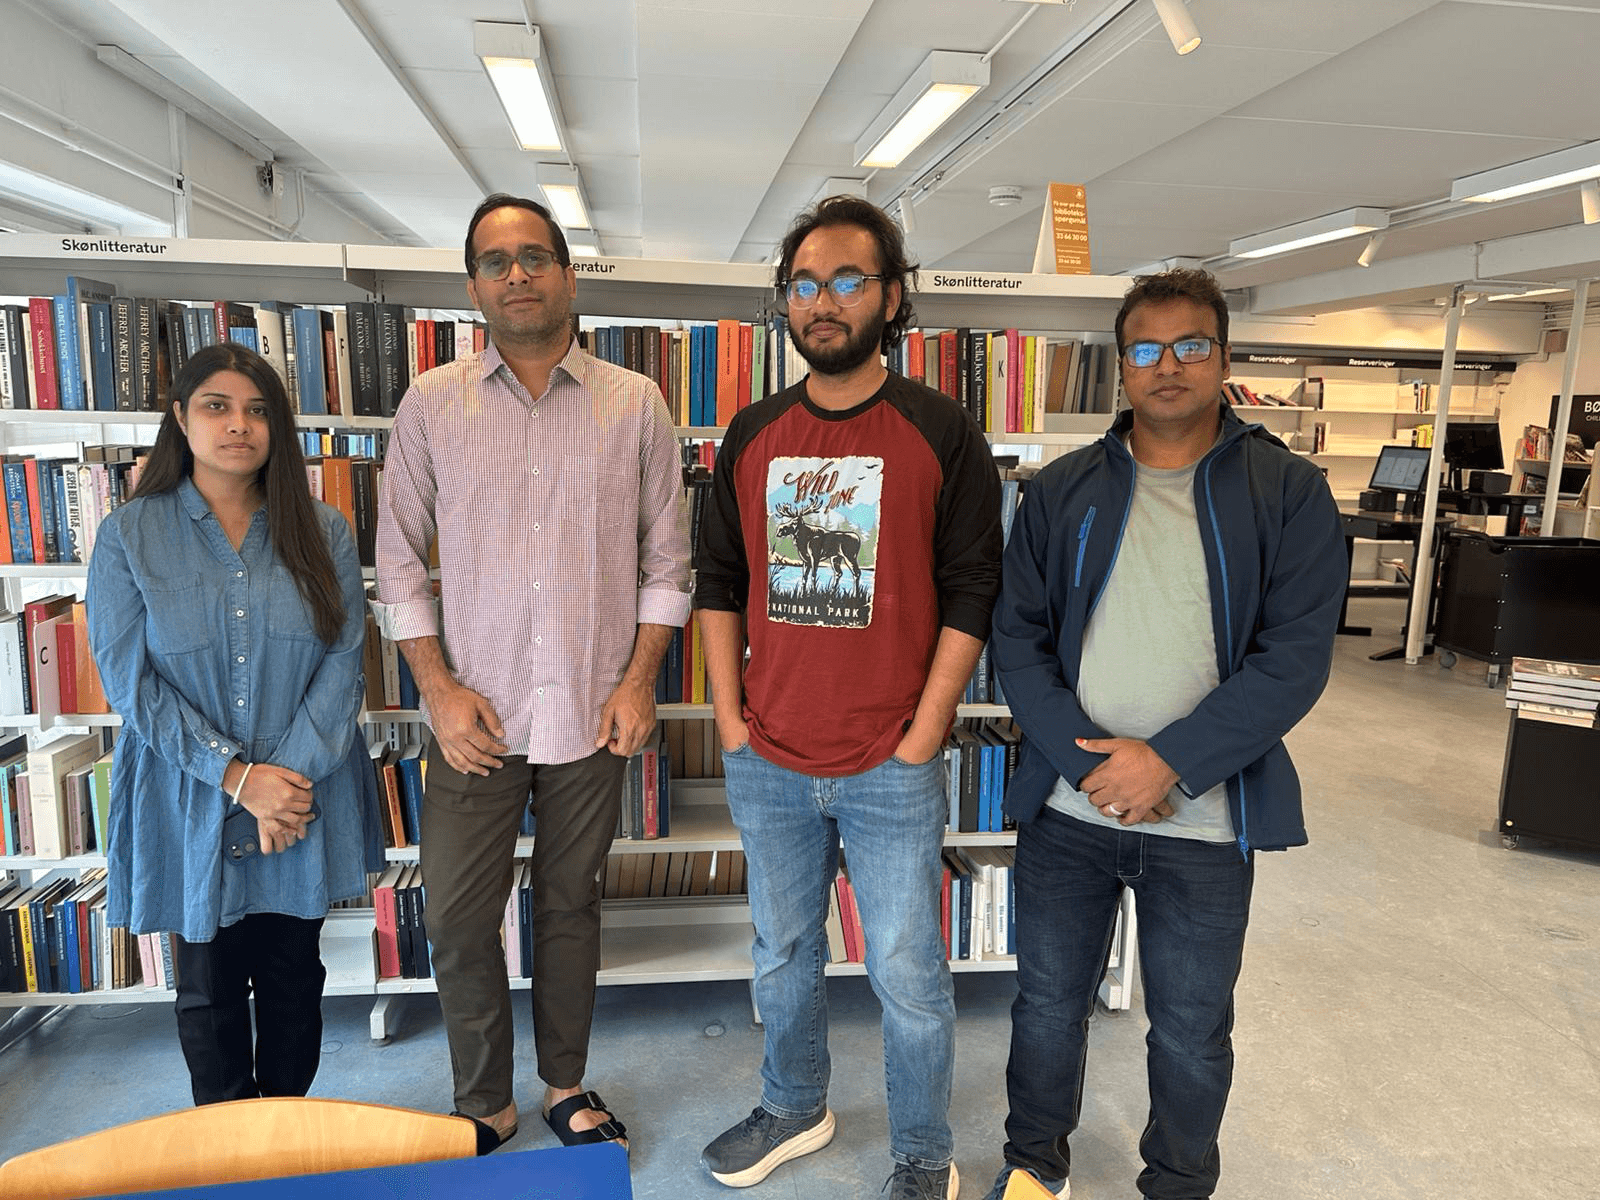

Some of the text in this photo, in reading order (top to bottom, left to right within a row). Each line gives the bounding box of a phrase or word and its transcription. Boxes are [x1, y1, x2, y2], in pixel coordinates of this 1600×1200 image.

[62, 239, 167, 254] Skønlitteratur
[570, 261, 616, 273] eratur
[934, 276, 1022, 289] Skønlitteratur
[118, 304, 128, 336] JEFFREY
[140, 305, 149, 337] JEFFREY
[356, 312, 365, 354] FALCONES
[383, 313, 392, 355] FALCONES
[59, 327, 68, 360] ALLENDE
[263, 336, 269, 354] B
[974, 337, 984, 362] Hella
[119, 338, 129, 372] ARCHER
[140, 340, 150, 374] ARCHER
[1249, 354, 1297, 365] Reserveringer
[1348, 358, 1396, 368] Reserveringer
[974, 362, 984, 384] Joof
[998, 360, 1004, 378] K
[66, 470, 78, 489] JESPER
[68, 490, 78, 506] BERNT
[772, 602, 859, 618] NATIONAL PARK
[40, 646, 48, 665] C
